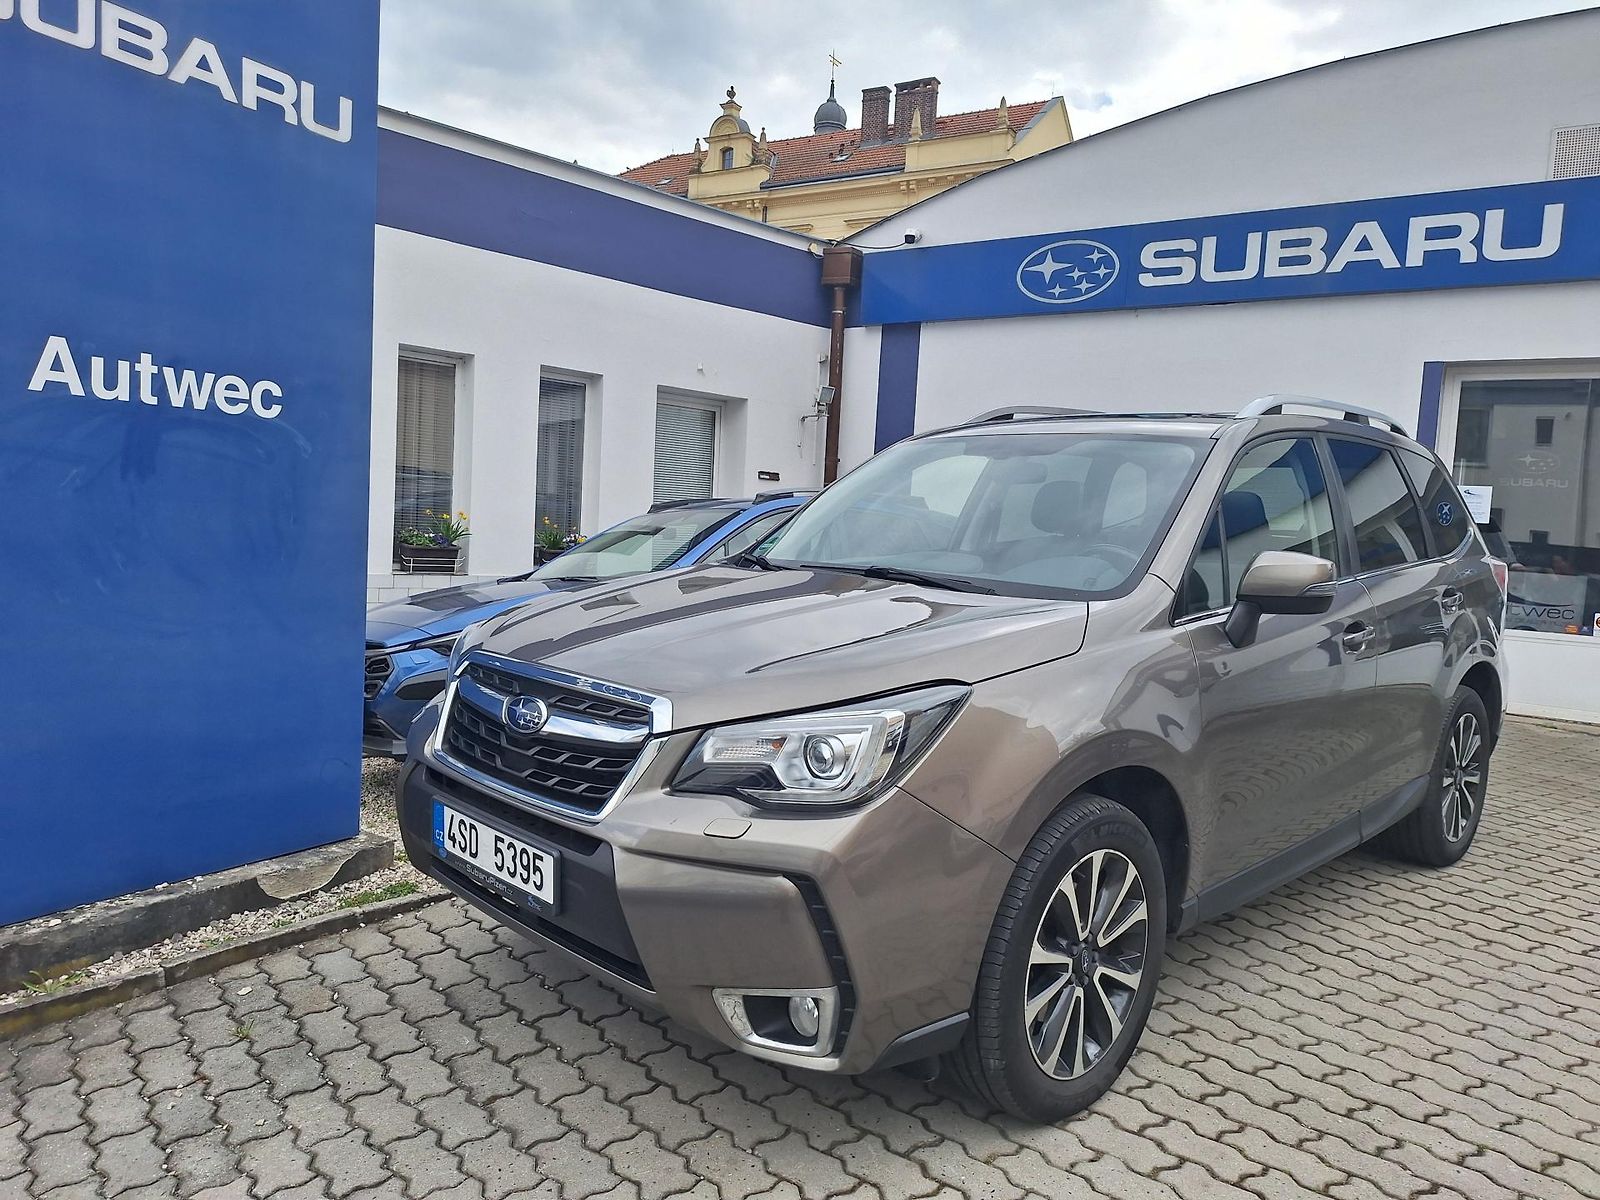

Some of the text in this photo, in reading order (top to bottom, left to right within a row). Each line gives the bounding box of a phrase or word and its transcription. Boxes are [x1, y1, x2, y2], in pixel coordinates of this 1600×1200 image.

[0, 0, 353, 143] UBARU
[1139, 203, 1565, 288] SUBARU
[27, 335, 283, 419] Autwec
[1499, 477, 1569, 489] SUBARU
[1506, 602, 1575, 620] twec
[435, 829, 444, 842] CZ
[447, 814, 544, 891] 4SD 5395
